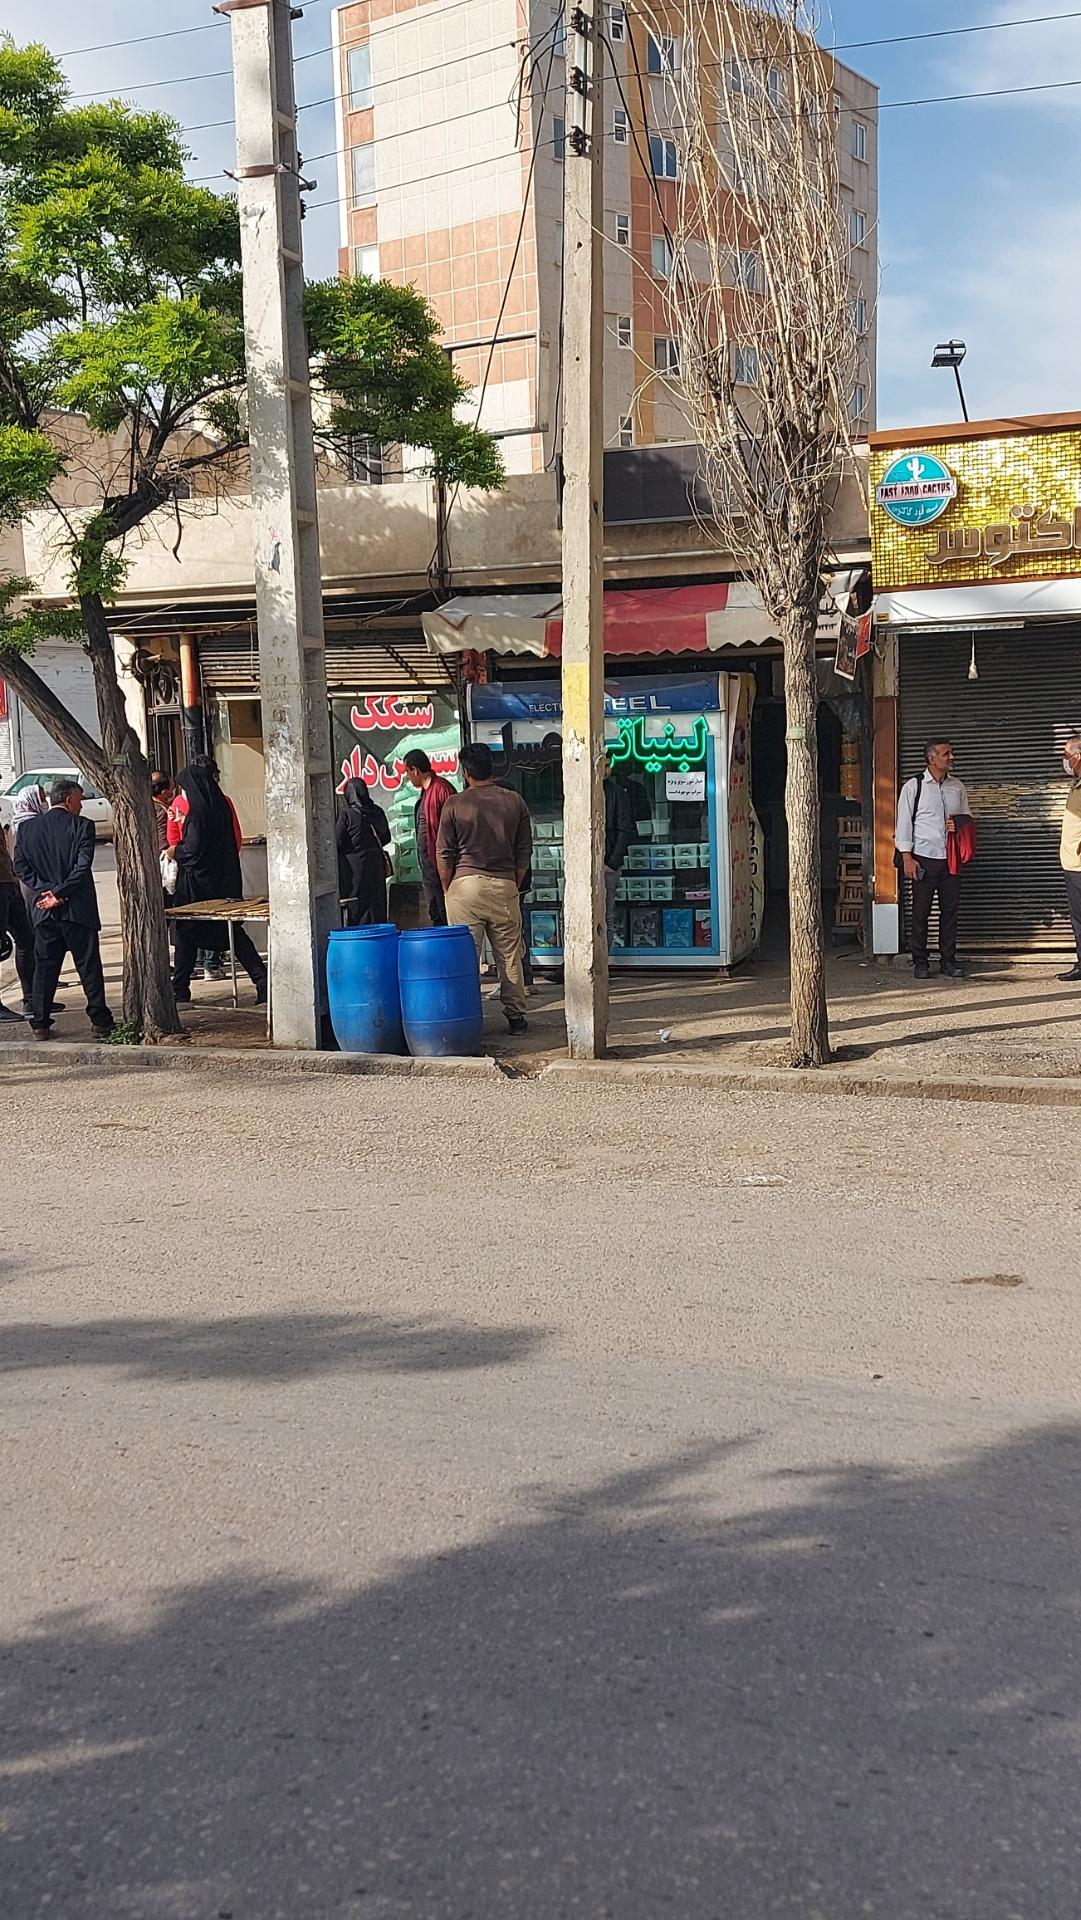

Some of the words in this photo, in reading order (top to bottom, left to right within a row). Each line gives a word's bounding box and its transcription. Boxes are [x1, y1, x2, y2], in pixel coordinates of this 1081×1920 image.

[880, 487, 898, 499] FAST
[922, 482, 951, 494] CACTUS
[925, 504, 1081, 567] اکتوس
[528, 702, 563, 713] ELECT
[603, 695, 671, 711] TEEL
[604, 716, 709, 773] لبنیات
